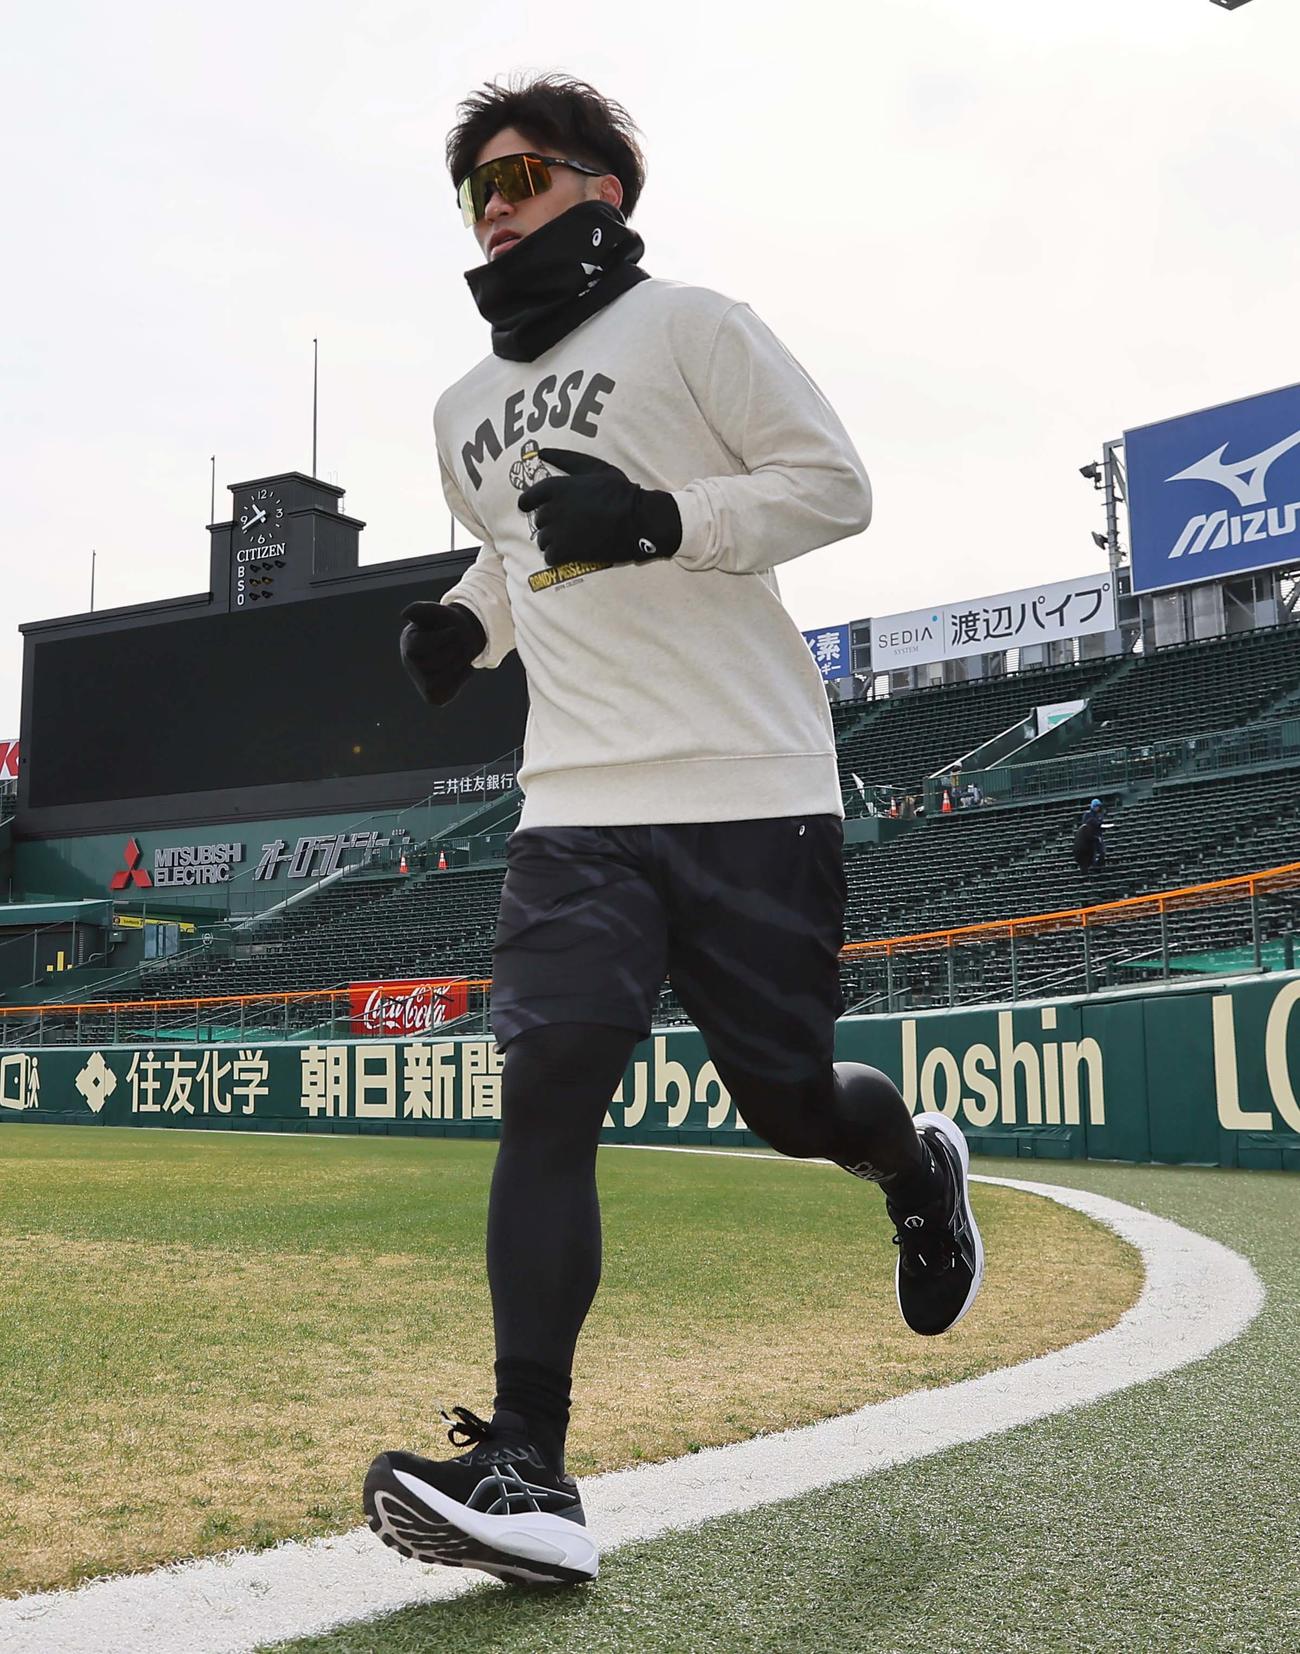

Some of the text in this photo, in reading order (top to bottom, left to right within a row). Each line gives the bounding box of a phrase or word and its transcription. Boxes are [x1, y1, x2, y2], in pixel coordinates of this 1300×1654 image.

[462, 370, 615, 491] MESSE
[258, 489, 267, 500] 12
[276, 508, 283, 518] 3
[258, 534, 266, 544] 6
[1168, 501, 1300, 559] MIZU
[237, 543, 285, 562] CITIZEN
[951, 582, 1110, 646] 渡辺パイプ
[803, 632, 841, 662] 素
[878, 627, 933, 649] SEDIA
[432, 773, 514, 795] 三井住友銀行
[154, 842, 241, 868] MITSUBISHI
[253, 831, 410, 880] オーロラビジ
[154, 864, 230, 887] ELECTRIC
[126, 1050, 269, 1114] 住友化学
[300, 1042, 506, 1120] 朝日新聞
[602, 1035, 748, 1129] ubo
[901, 1007, 1106, 1128] Joshin
